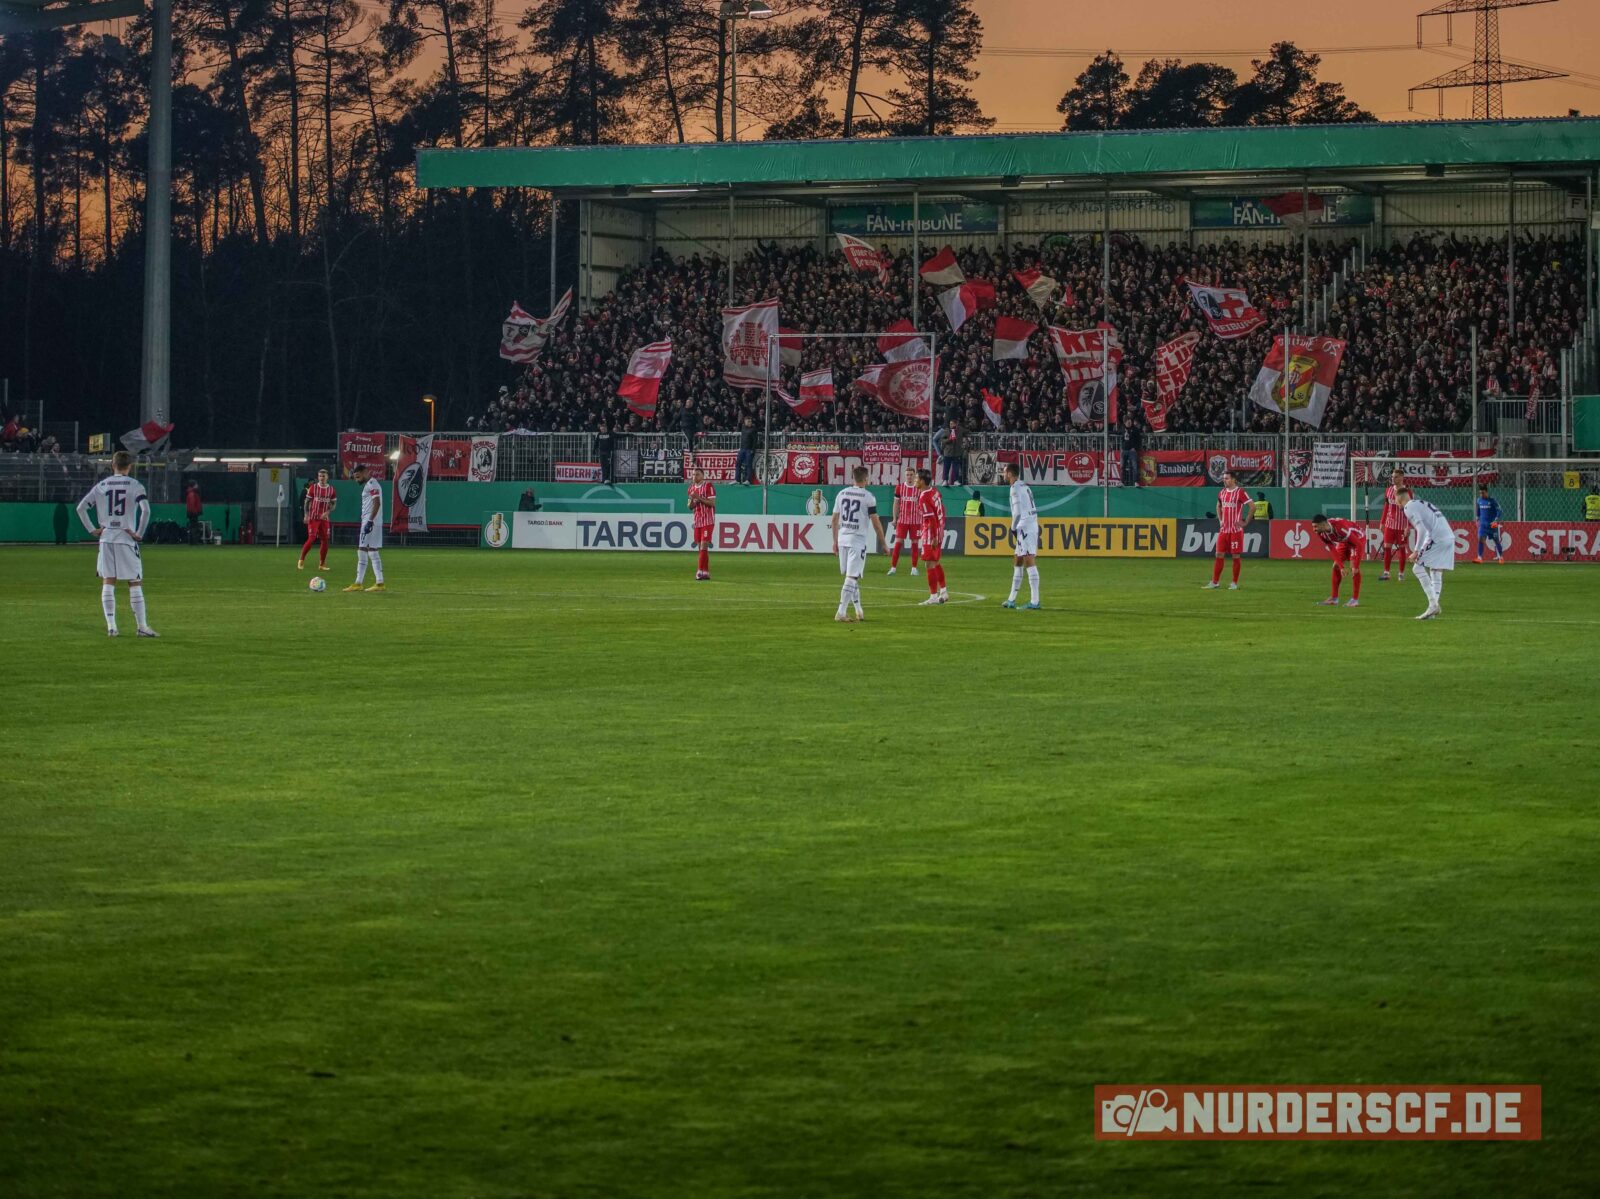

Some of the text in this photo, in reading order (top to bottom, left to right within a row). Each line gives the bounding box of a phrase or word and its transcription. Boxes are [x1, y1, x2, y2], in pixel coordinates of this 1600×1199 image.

[343, 441, 383, 453] Fanatics
[1230, 454, 1260, 468] Ortenau
[1399, 461, 1427, 475] Red
[105, 489, 127, 517] 15
[841, 498, 861, 523] 32
[576, 520, 815, 550] TARGO BANK
[1182, 524, 1262, 553] bwn
